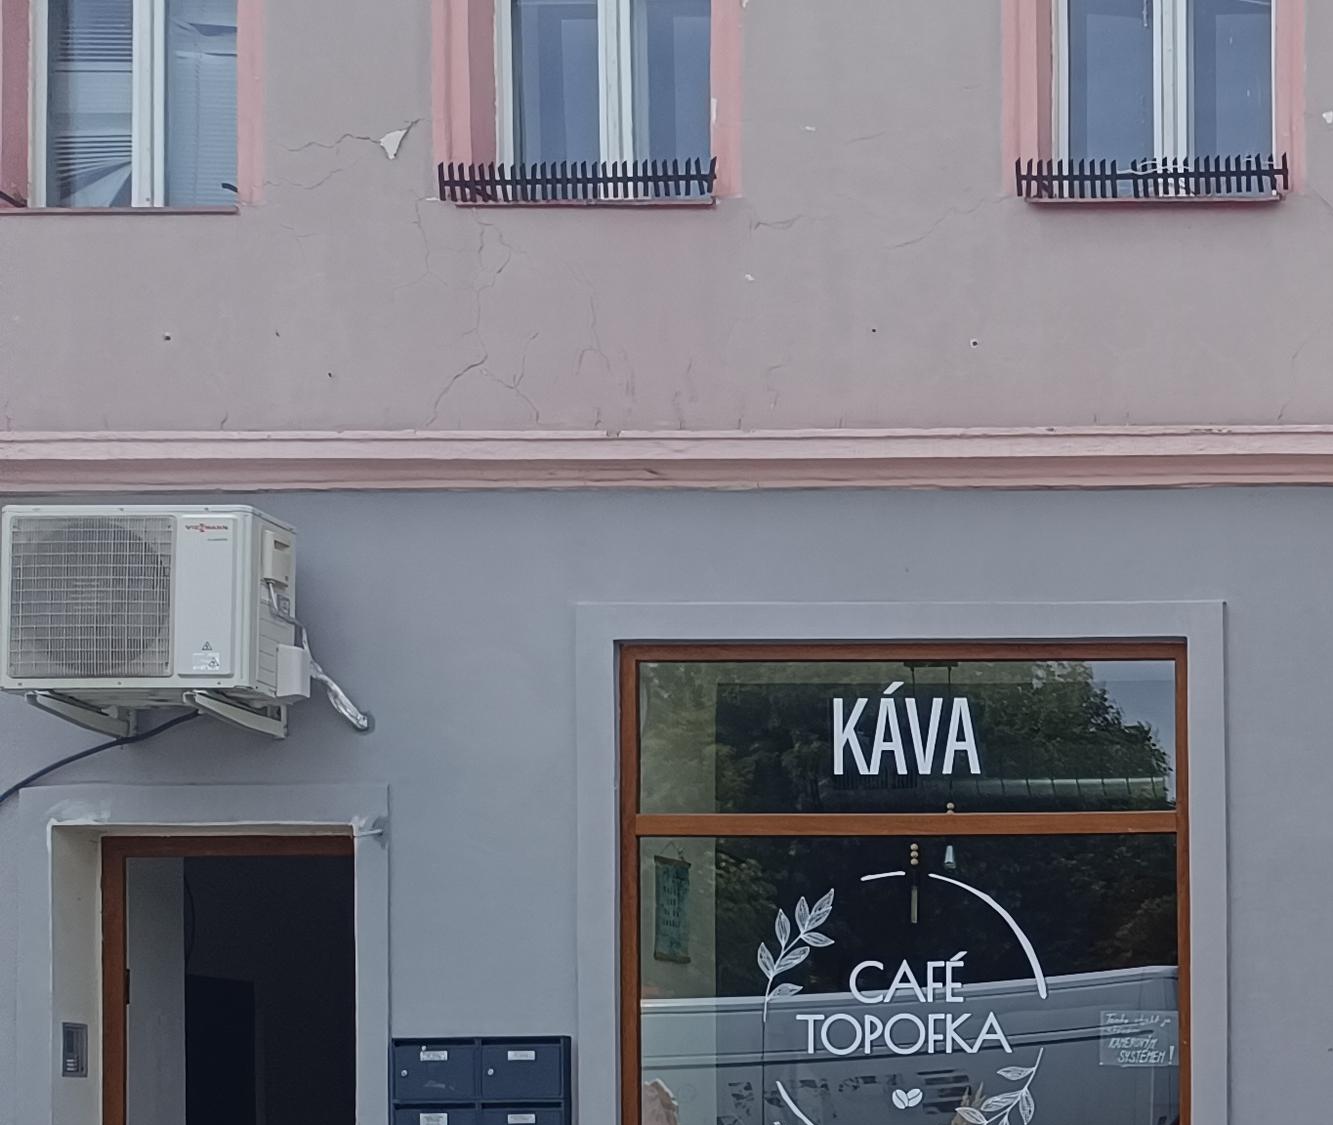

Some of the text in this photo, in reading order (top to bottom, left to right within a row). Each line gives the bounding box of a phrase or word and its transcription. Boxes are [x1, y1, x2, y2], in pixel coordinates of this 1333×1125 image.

[832, 681, 981, 775] KÁVA
[849, 951, 966, 1004] CAFÉ
[796, 1011, 1013, 1055] TOPOFKA
